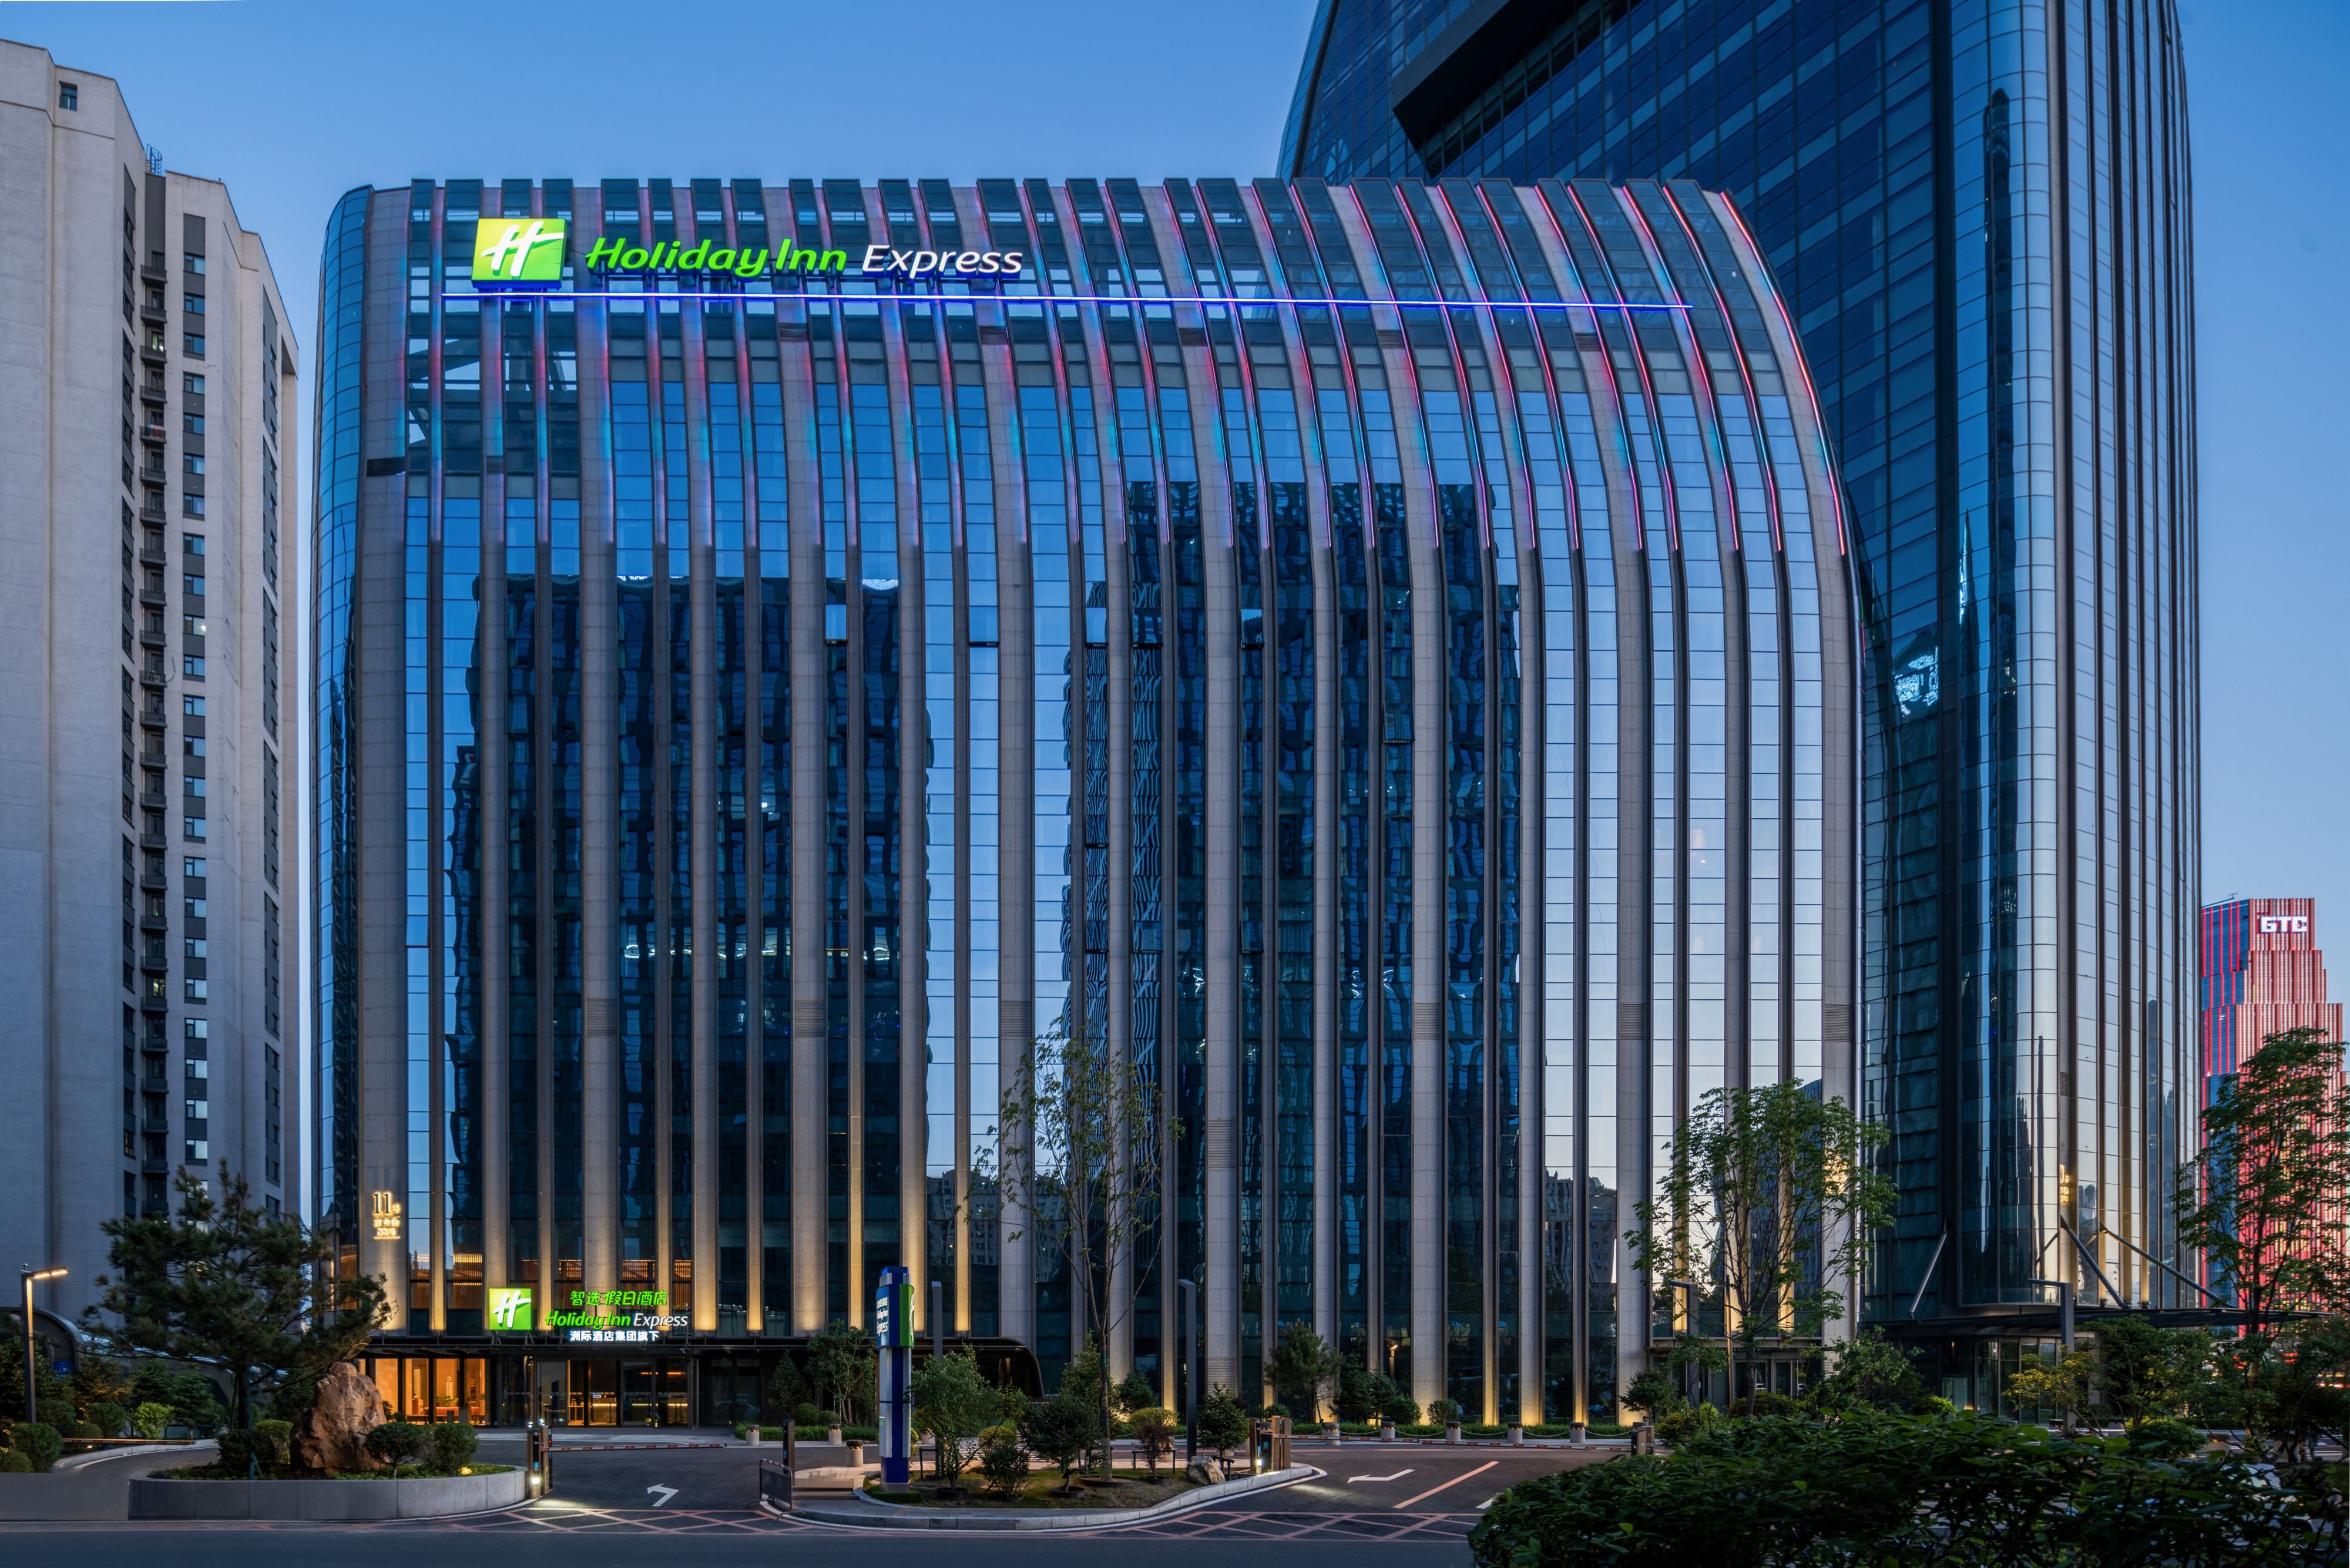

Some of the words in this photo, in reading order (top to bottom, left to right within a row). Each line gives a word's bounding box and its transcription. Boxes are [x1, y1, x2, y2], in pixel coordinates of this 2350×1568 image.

[585, 237, 769, 278] Holiday
[775, 237, 847, 271] Inn
[862, 244, 1023, 279] Express
[570, 1290, 668, 1306] 智选假日酒店
[545, 1311, 606, 1330] Holiday
[606, 1311, 631, 1327] Inn
[633, 1312, 689, 1329] Express
[570, 1330, 660, 1342] 洲际酒店集团旗下
